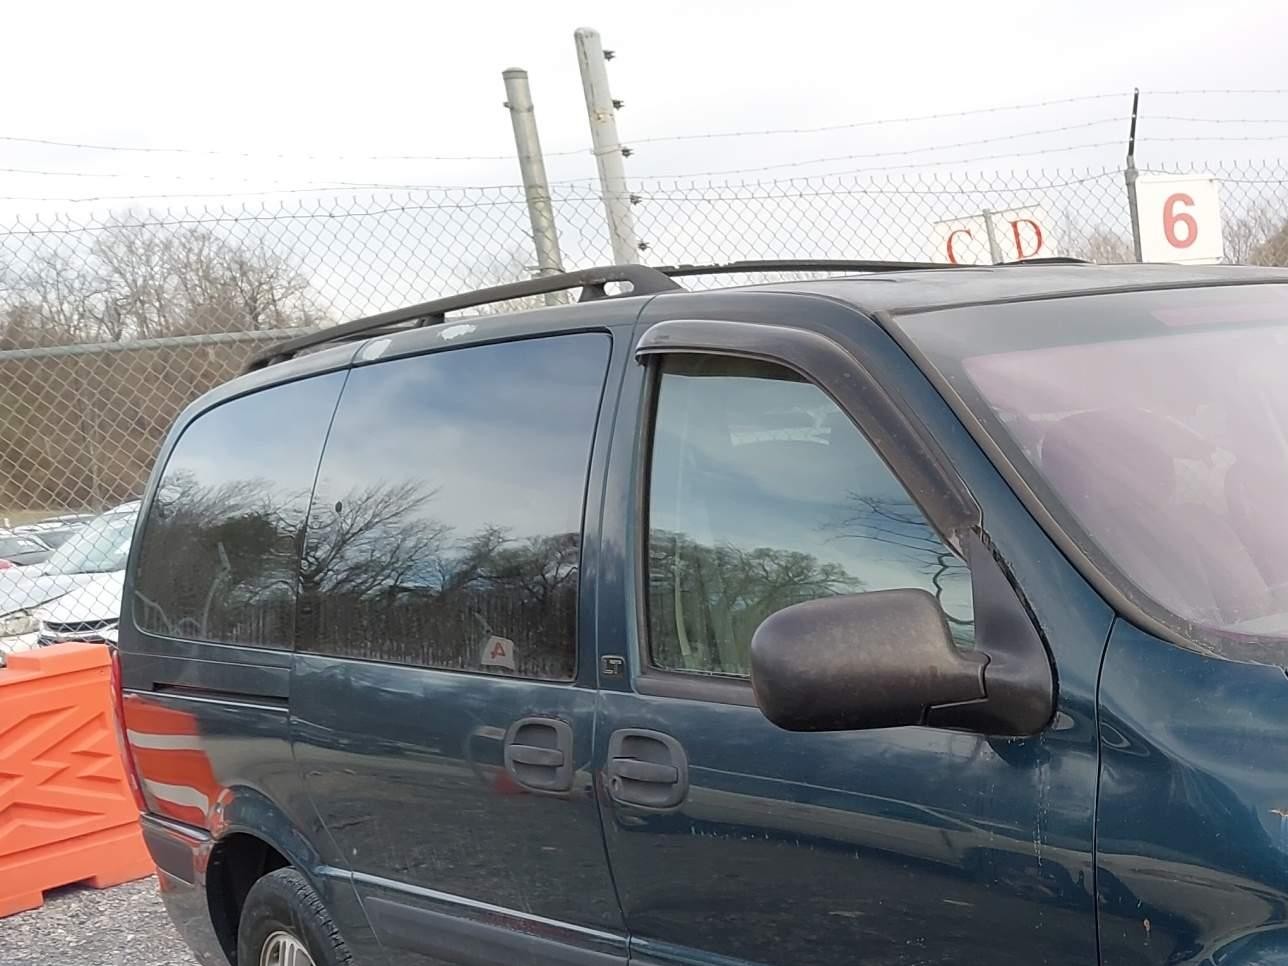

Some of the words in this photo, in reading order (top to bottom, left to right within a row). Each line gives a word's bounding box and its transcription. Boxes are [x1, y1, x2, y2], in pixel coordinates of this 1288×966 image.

[1008, 218, 1042, 259] D
[1162, 192, 1199, 249] 6
[946, 229, 974, 265] C
